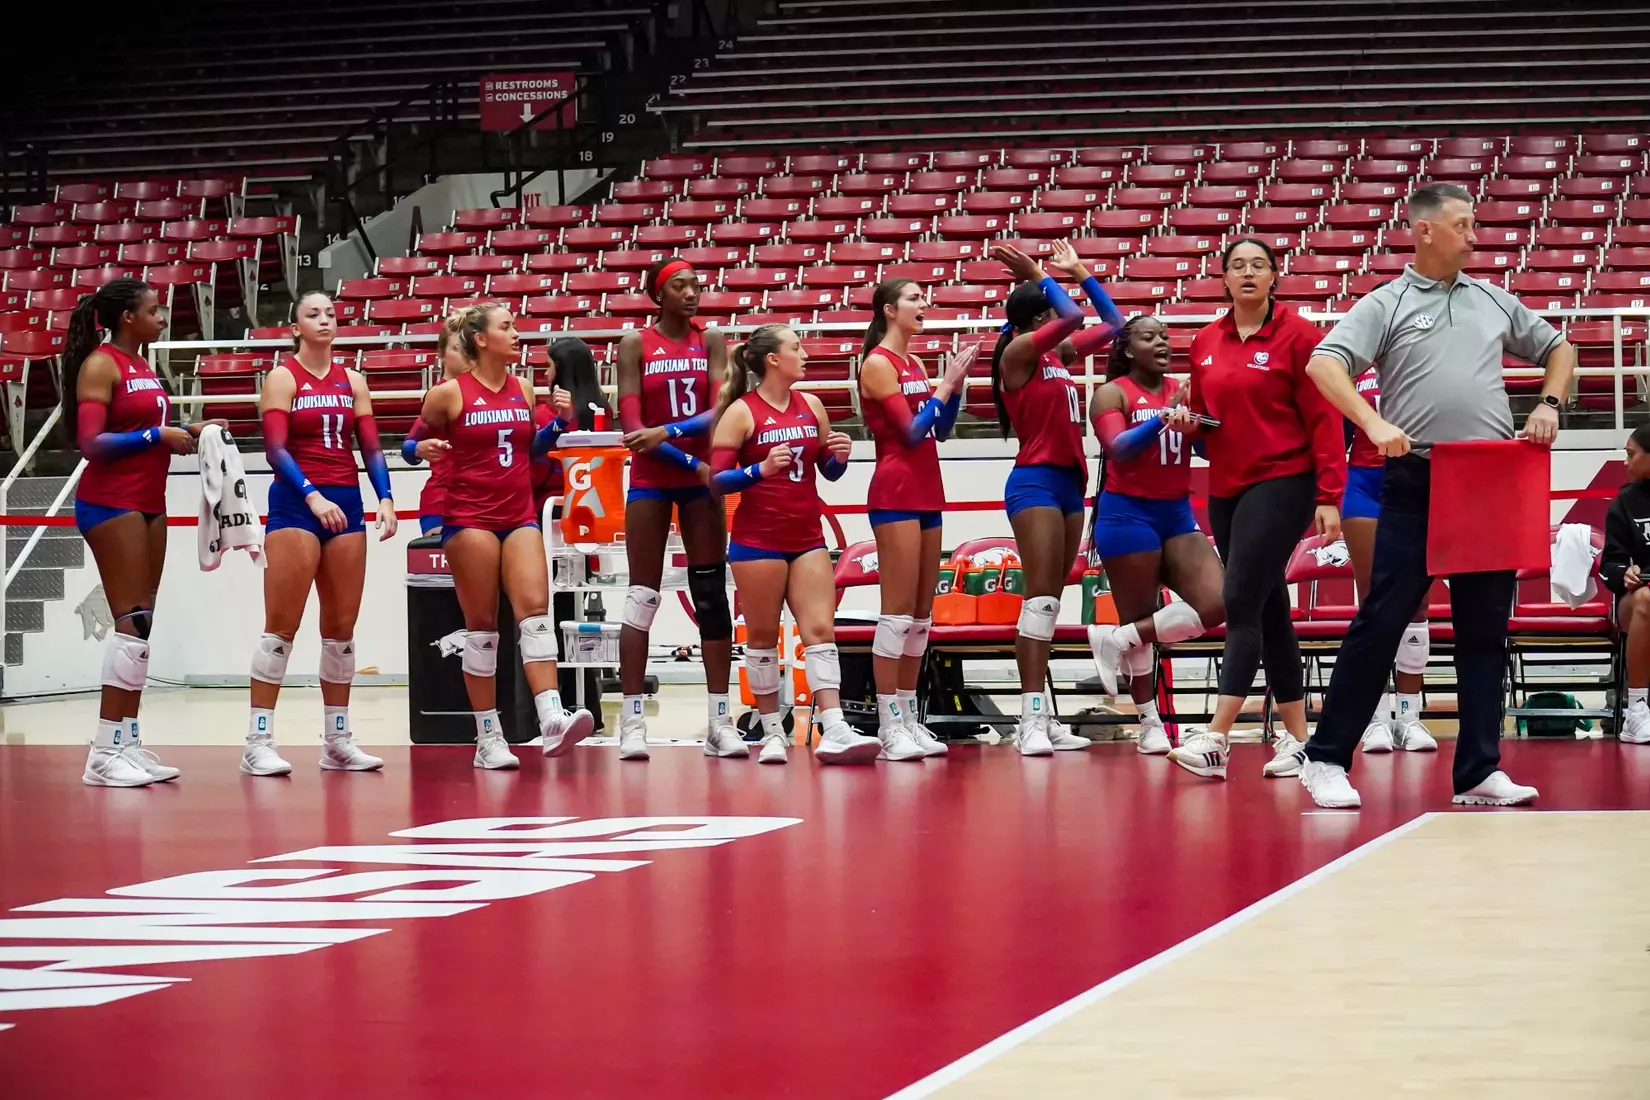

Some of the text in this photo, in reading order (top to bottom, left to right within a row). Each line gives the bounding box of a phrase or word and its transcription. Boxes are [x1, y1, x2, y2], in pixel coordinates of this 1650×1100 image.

[719, 40, 734, 50] 24
[694, 58, 710, 68] 23
[495, 80, 558, 90] RESTROOMS
[670, 76, 686, 85] 22
[495, 90, 568, 102] CONCESSIONS
[619, 114, 636, 124] 20
[601, 132, 614, 142] 19
[579, 151, 593, 162] 18
[524, 194, 541, 208] XIT
[298, 255, 312, 266] 13
[1414, 314, 1434, 329] SEC
[644, 358, 690, 376] LOUISIANA
[291, 394, 338, 412] LOUISIANA
[667, 377, 697, 418] 13
[1064, 384, 1080, 424] 10
[464, 409, 514, 427] LOUISIANA
[322, 414, 345, 449] 11
[756, 426, 804, 446] LOUISIANA
[497, 428, 514, 468] 5
[1160, 429, 1182, 466] 19
[788, 446, 804, 482] 3
[568, 462, 592, 491] G
[938, 580, 949, 594] G
[984, 579, 996, 593] G
[1005, 576, 1012, 591] G
[0, 815, 804, 1022] ANSAS
